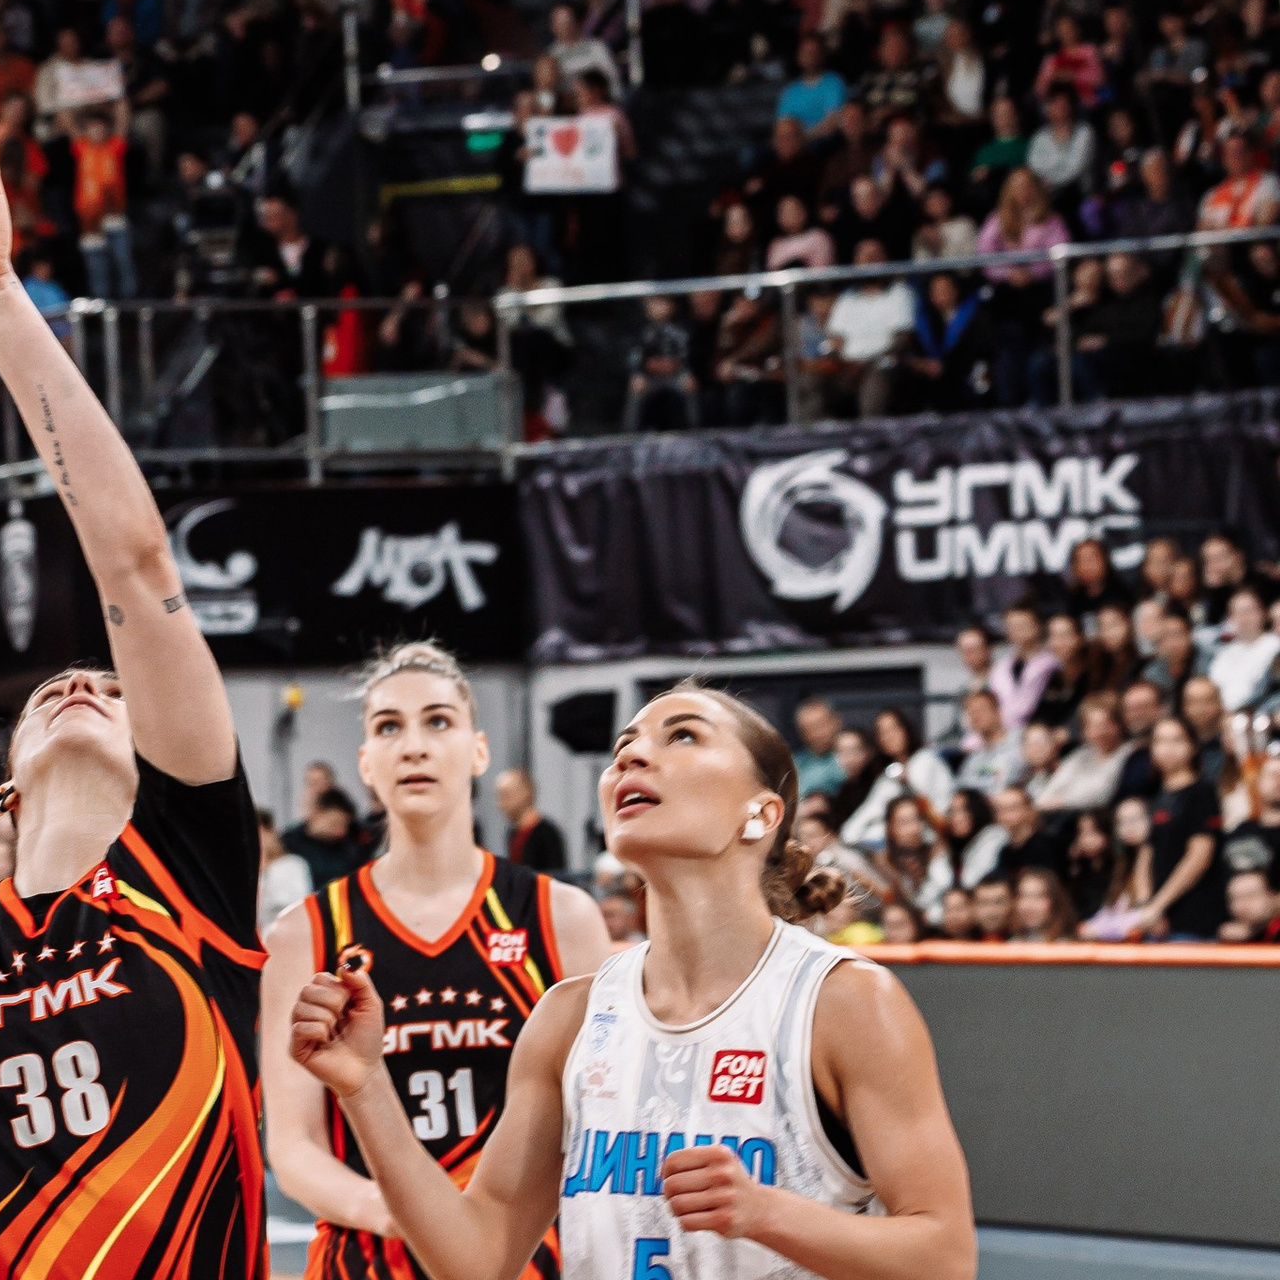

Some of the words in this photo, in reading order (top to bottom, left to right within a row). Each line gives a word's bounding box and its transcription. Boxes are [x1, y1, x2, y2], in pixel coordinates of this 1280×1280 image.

[892, 454, 1140, 526] УГМК
[488, 932, 525, 948] FON
[489, 946, 526, 963] BET
[714, 1054, 766, 1076] FON
[711, 1075, 764, 1099] BET
[407, 1066, 478, 1141] 31
